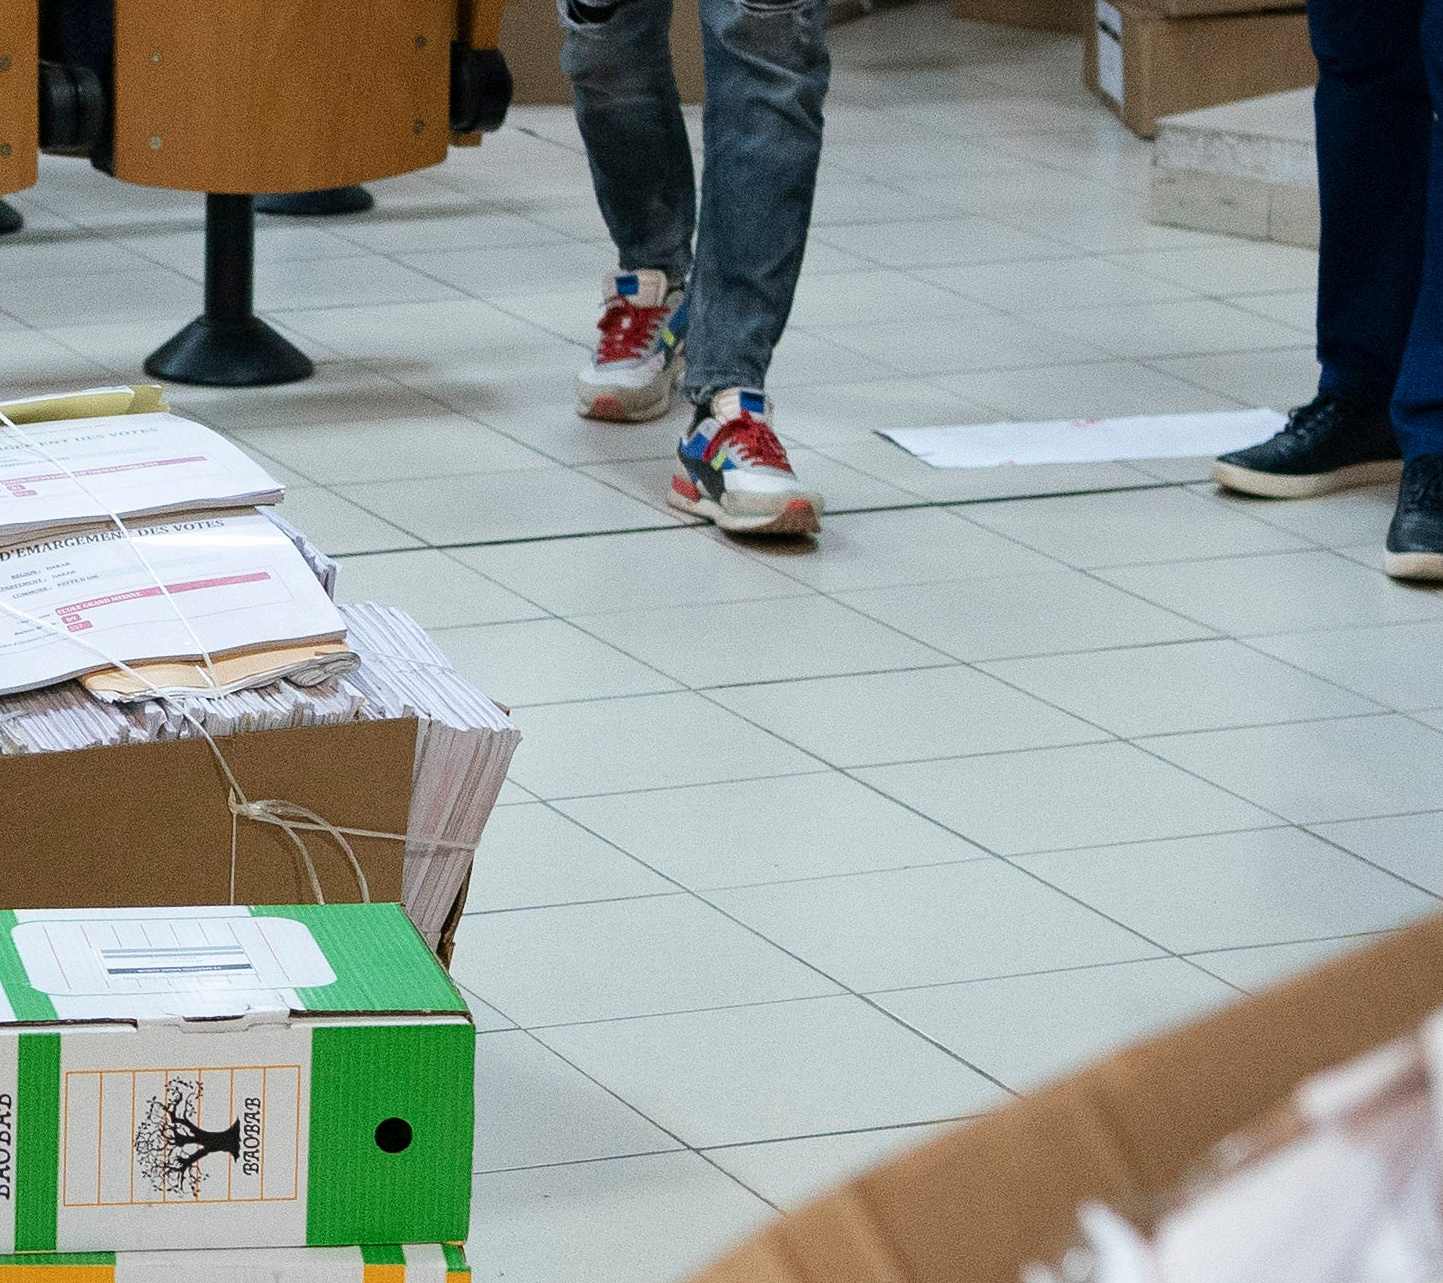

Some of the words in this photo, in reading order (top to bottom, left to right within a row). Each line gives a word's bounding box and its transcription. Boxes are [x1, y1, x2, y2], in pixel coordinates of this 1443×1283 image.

[137, 525, 169, 537] DES
[172, 519, 225, 531] VOTES
[242, 1096, 261, 1176] BAOBAB
